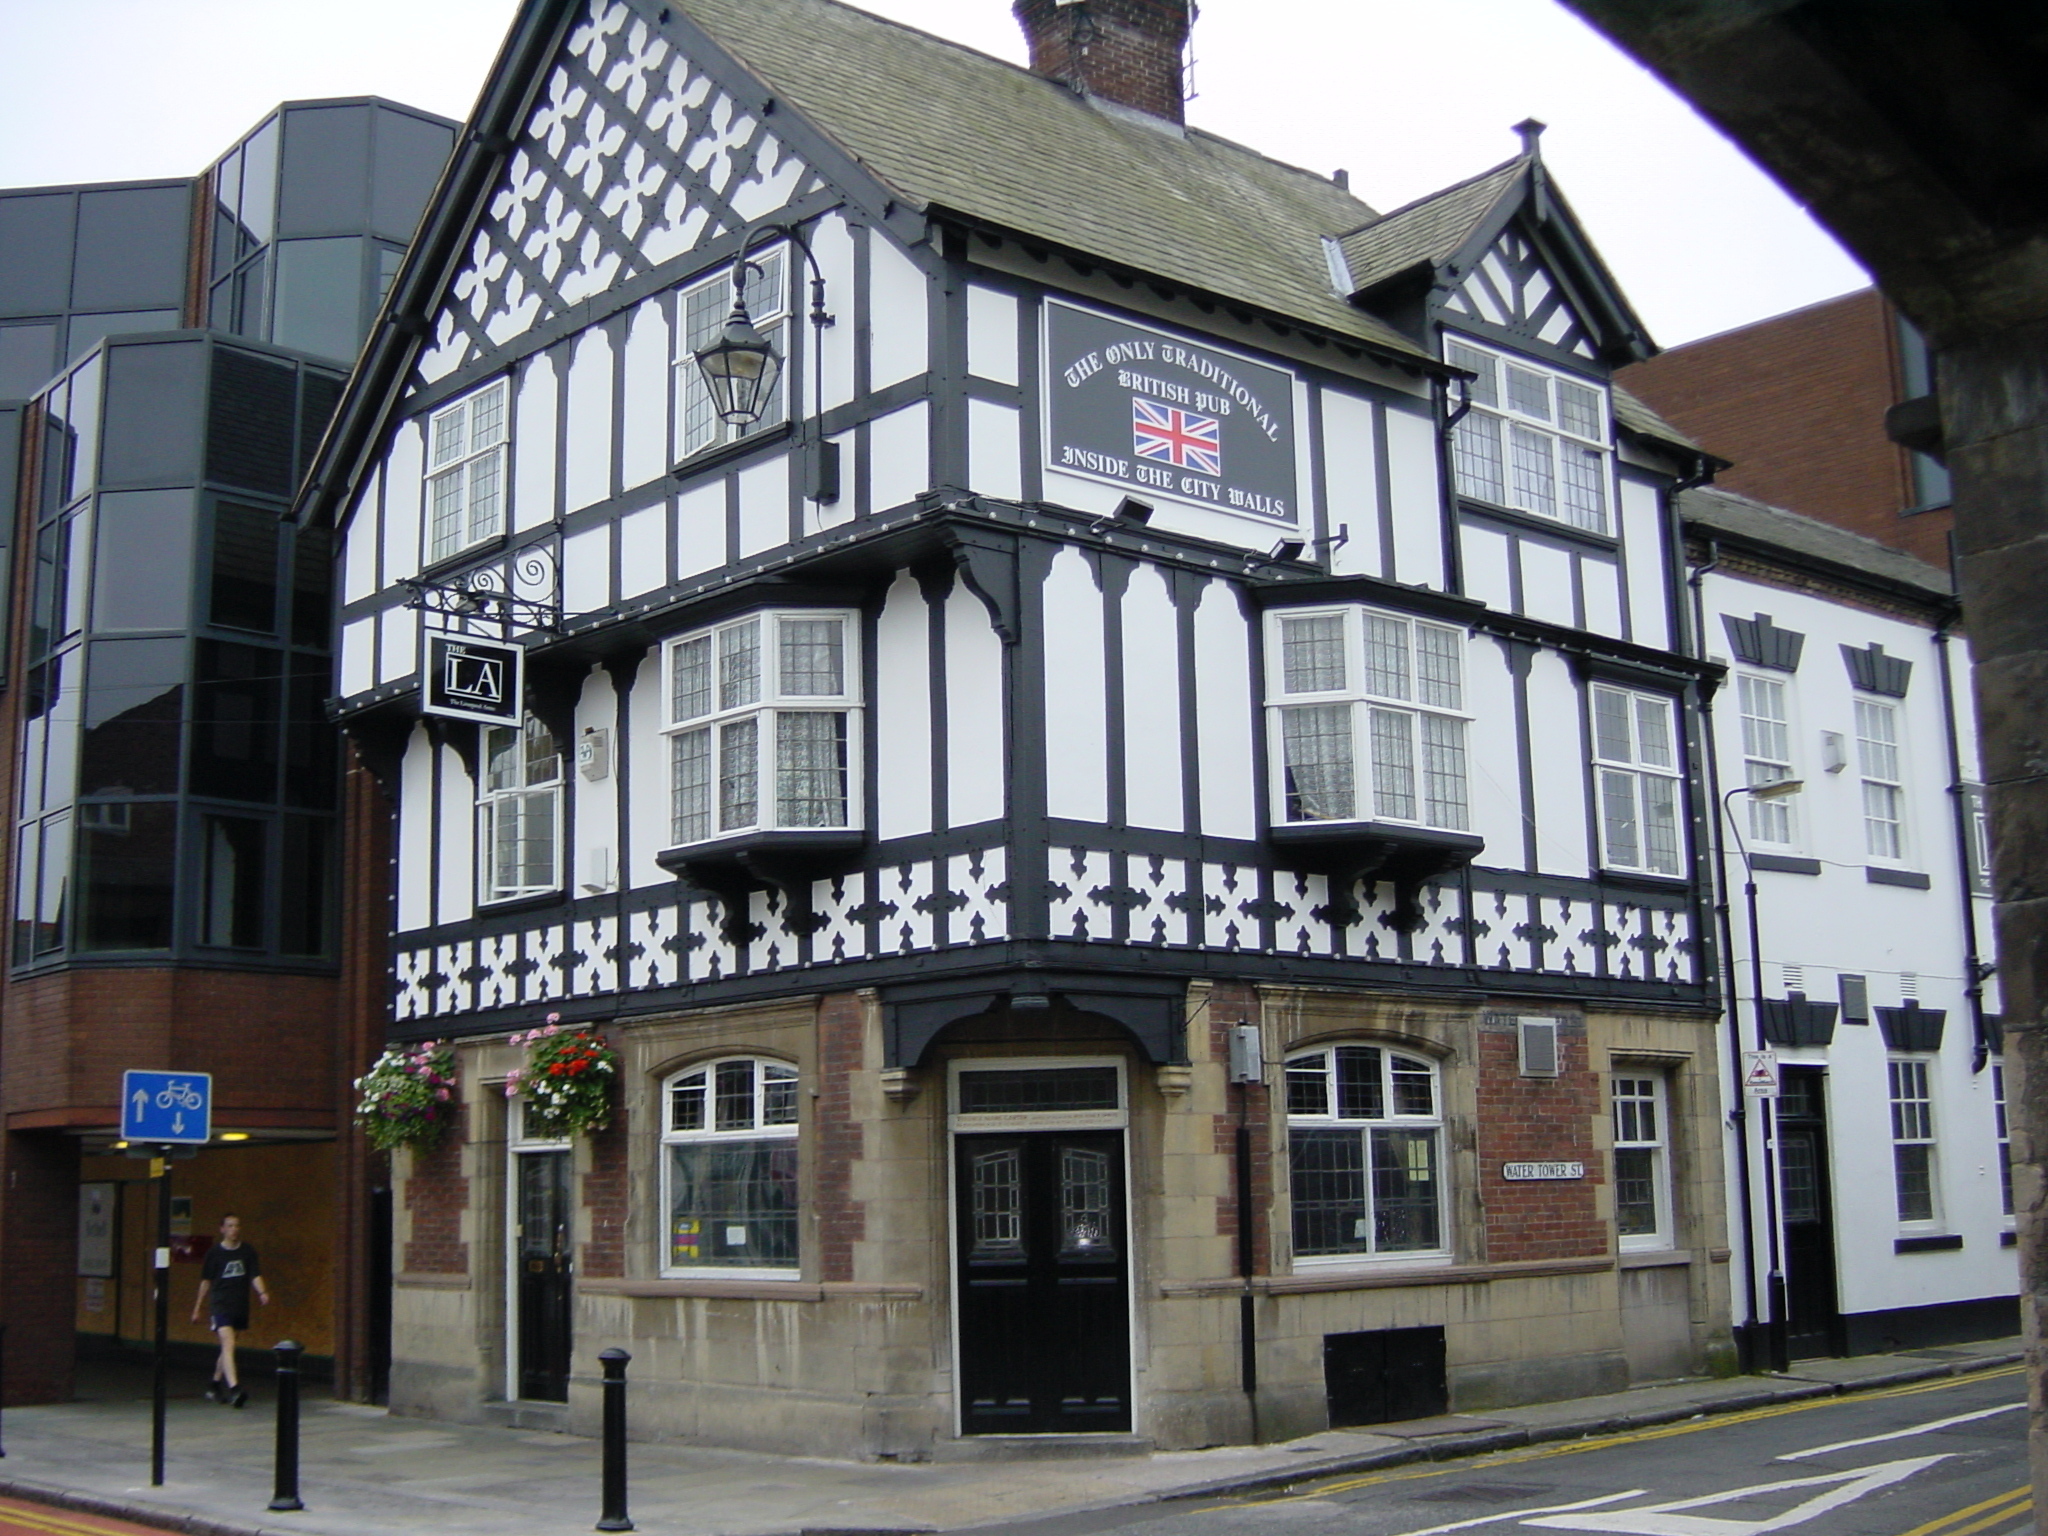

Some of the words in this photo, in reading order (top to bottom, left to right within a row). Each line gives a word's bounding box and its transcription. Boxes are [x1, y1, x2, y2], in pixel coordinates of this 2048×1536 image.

[1063, 351, 1103, 388] THE
[1105, 341, 1155, 366] ONLY
[1161, 344, 1279, 443] TRADITIONAL
[1117, 368, 1191, 404] BRITISH
[1194, 391, 1231, 417] PUB
[1061, 445, 1130, 480] INSIDE
[1136, 464, 1174, 490] THE
[1180, 475, 1221, 501] CITY
[1227, 486, 1285, 517] WALLS
[445, 644, 466, 655] THE
[447, 658, 501, 698] LA
[1506, 1165, 1534, 1178] WATER
[1538, 1164, 1567, 1178] TOWER
